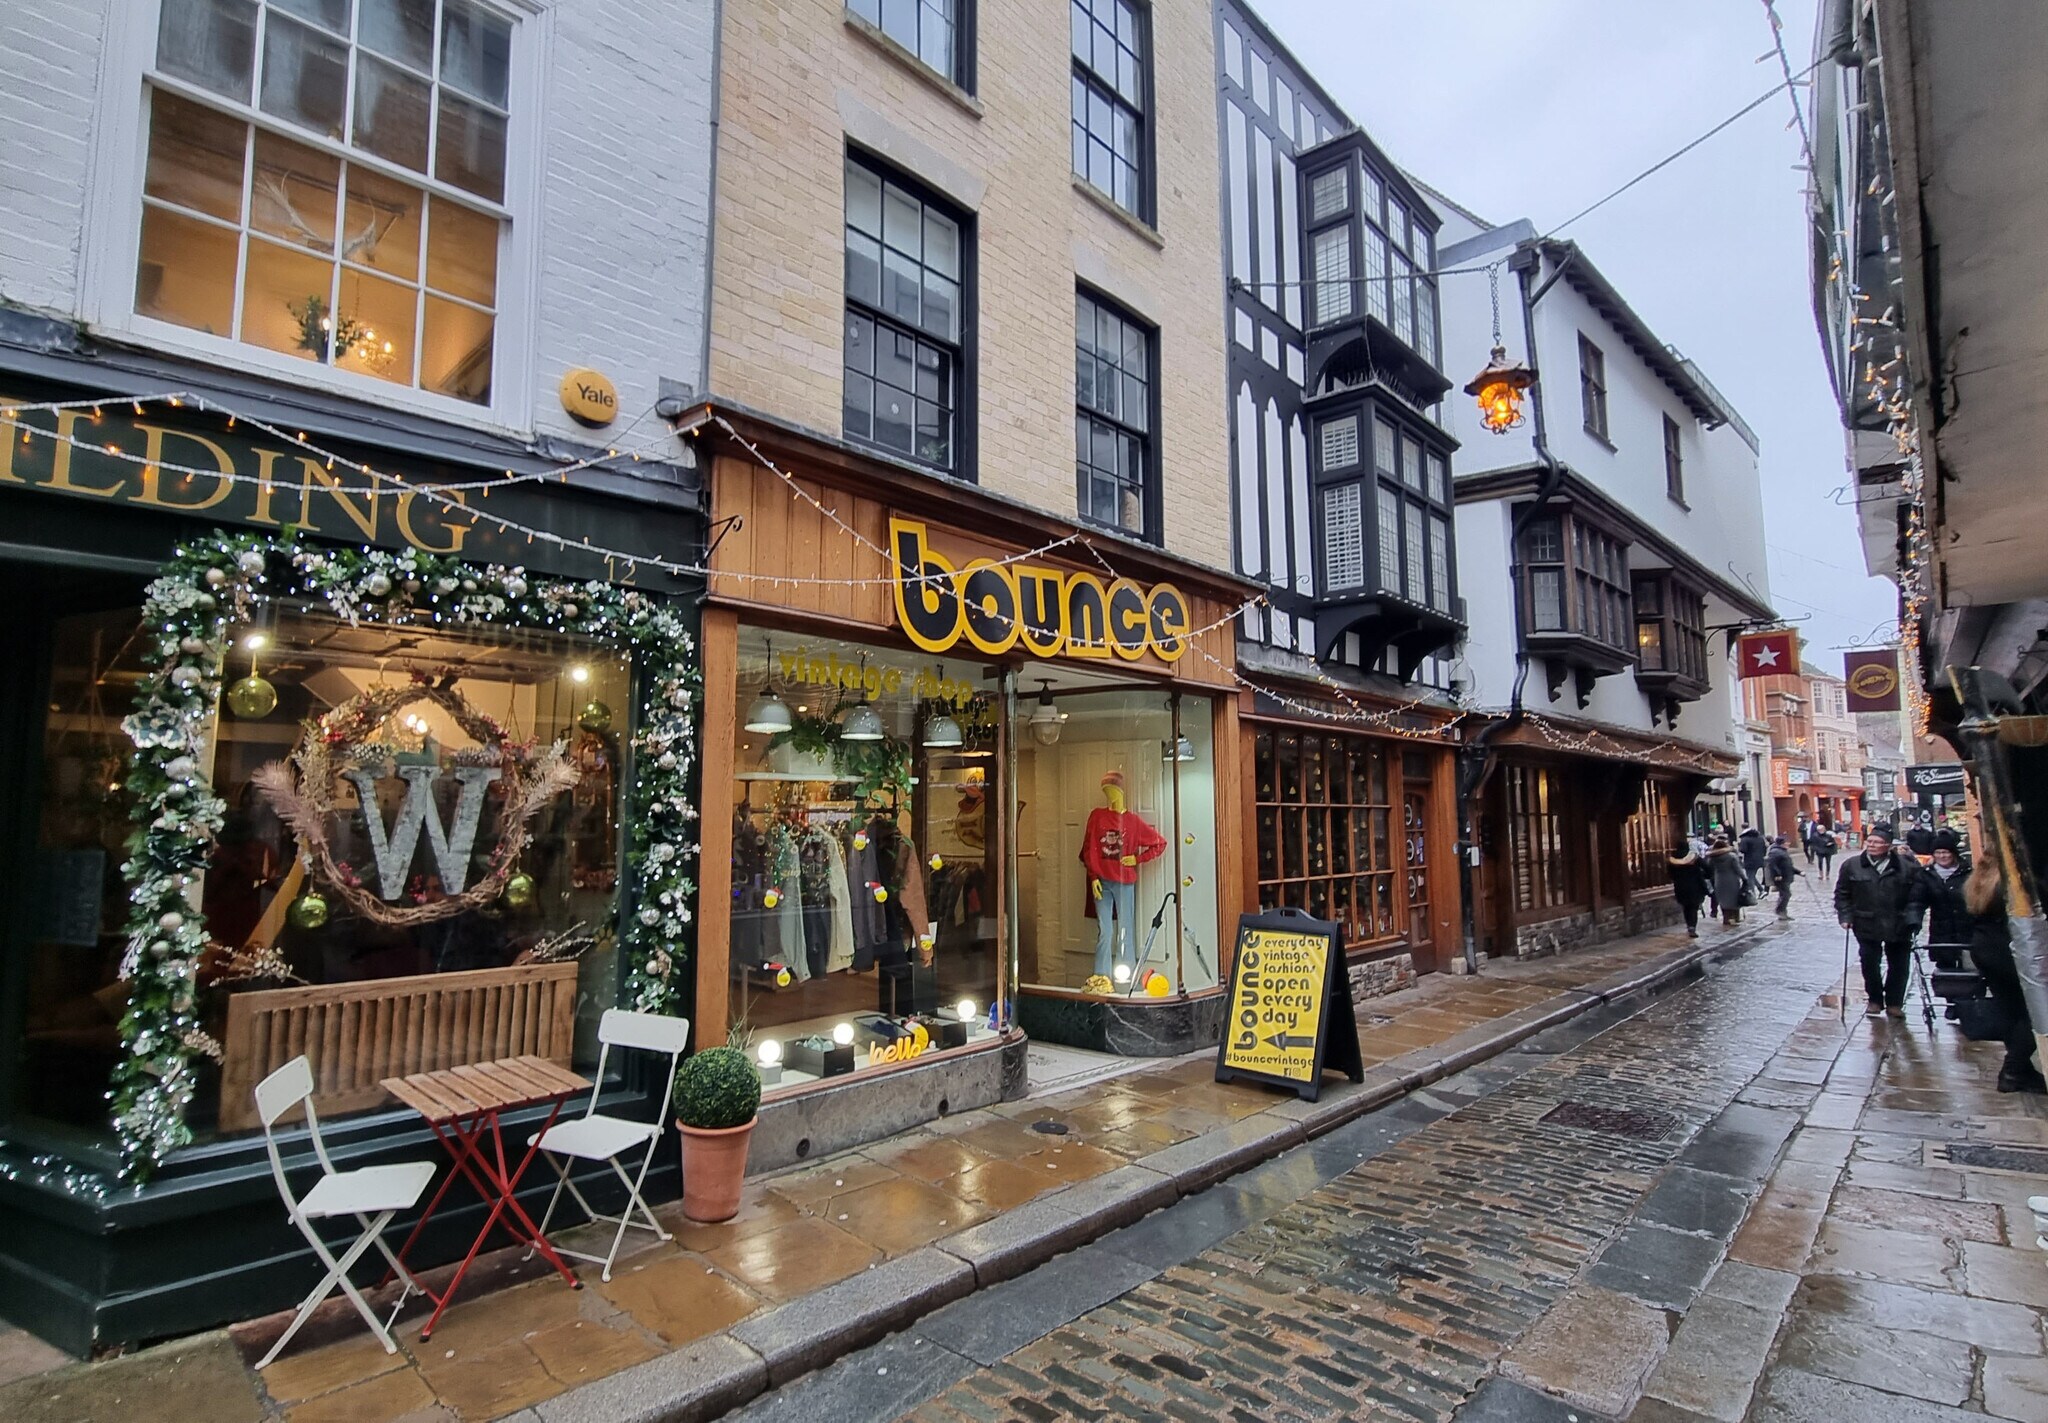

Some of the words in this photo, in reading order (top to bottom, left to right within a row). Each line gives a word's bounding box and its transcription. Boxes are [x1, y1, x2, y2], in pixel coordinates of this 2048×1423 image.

[576, 382, 614, 408] Yale
[606, 556, 636, 586] 12
[890, 518, 1189, 661] bounce
[779, 646, 903, 702] vintage
[912, 666, 974, 710] shop
[344, 762, 502, 900] W
[1264, 935, 1324, 950] everyday
[1263, 949, 1310, 963] vintage
[1263, 963, 1316, 974] fashions
[1234, 929, 1261, 1050] bounce
[1263, 978, 1311, 994] open
[1263, 995, 1313, 1012] every
[1262, 1008, 1298, 1029] day
[869, 1036, 923, 1065] hello
